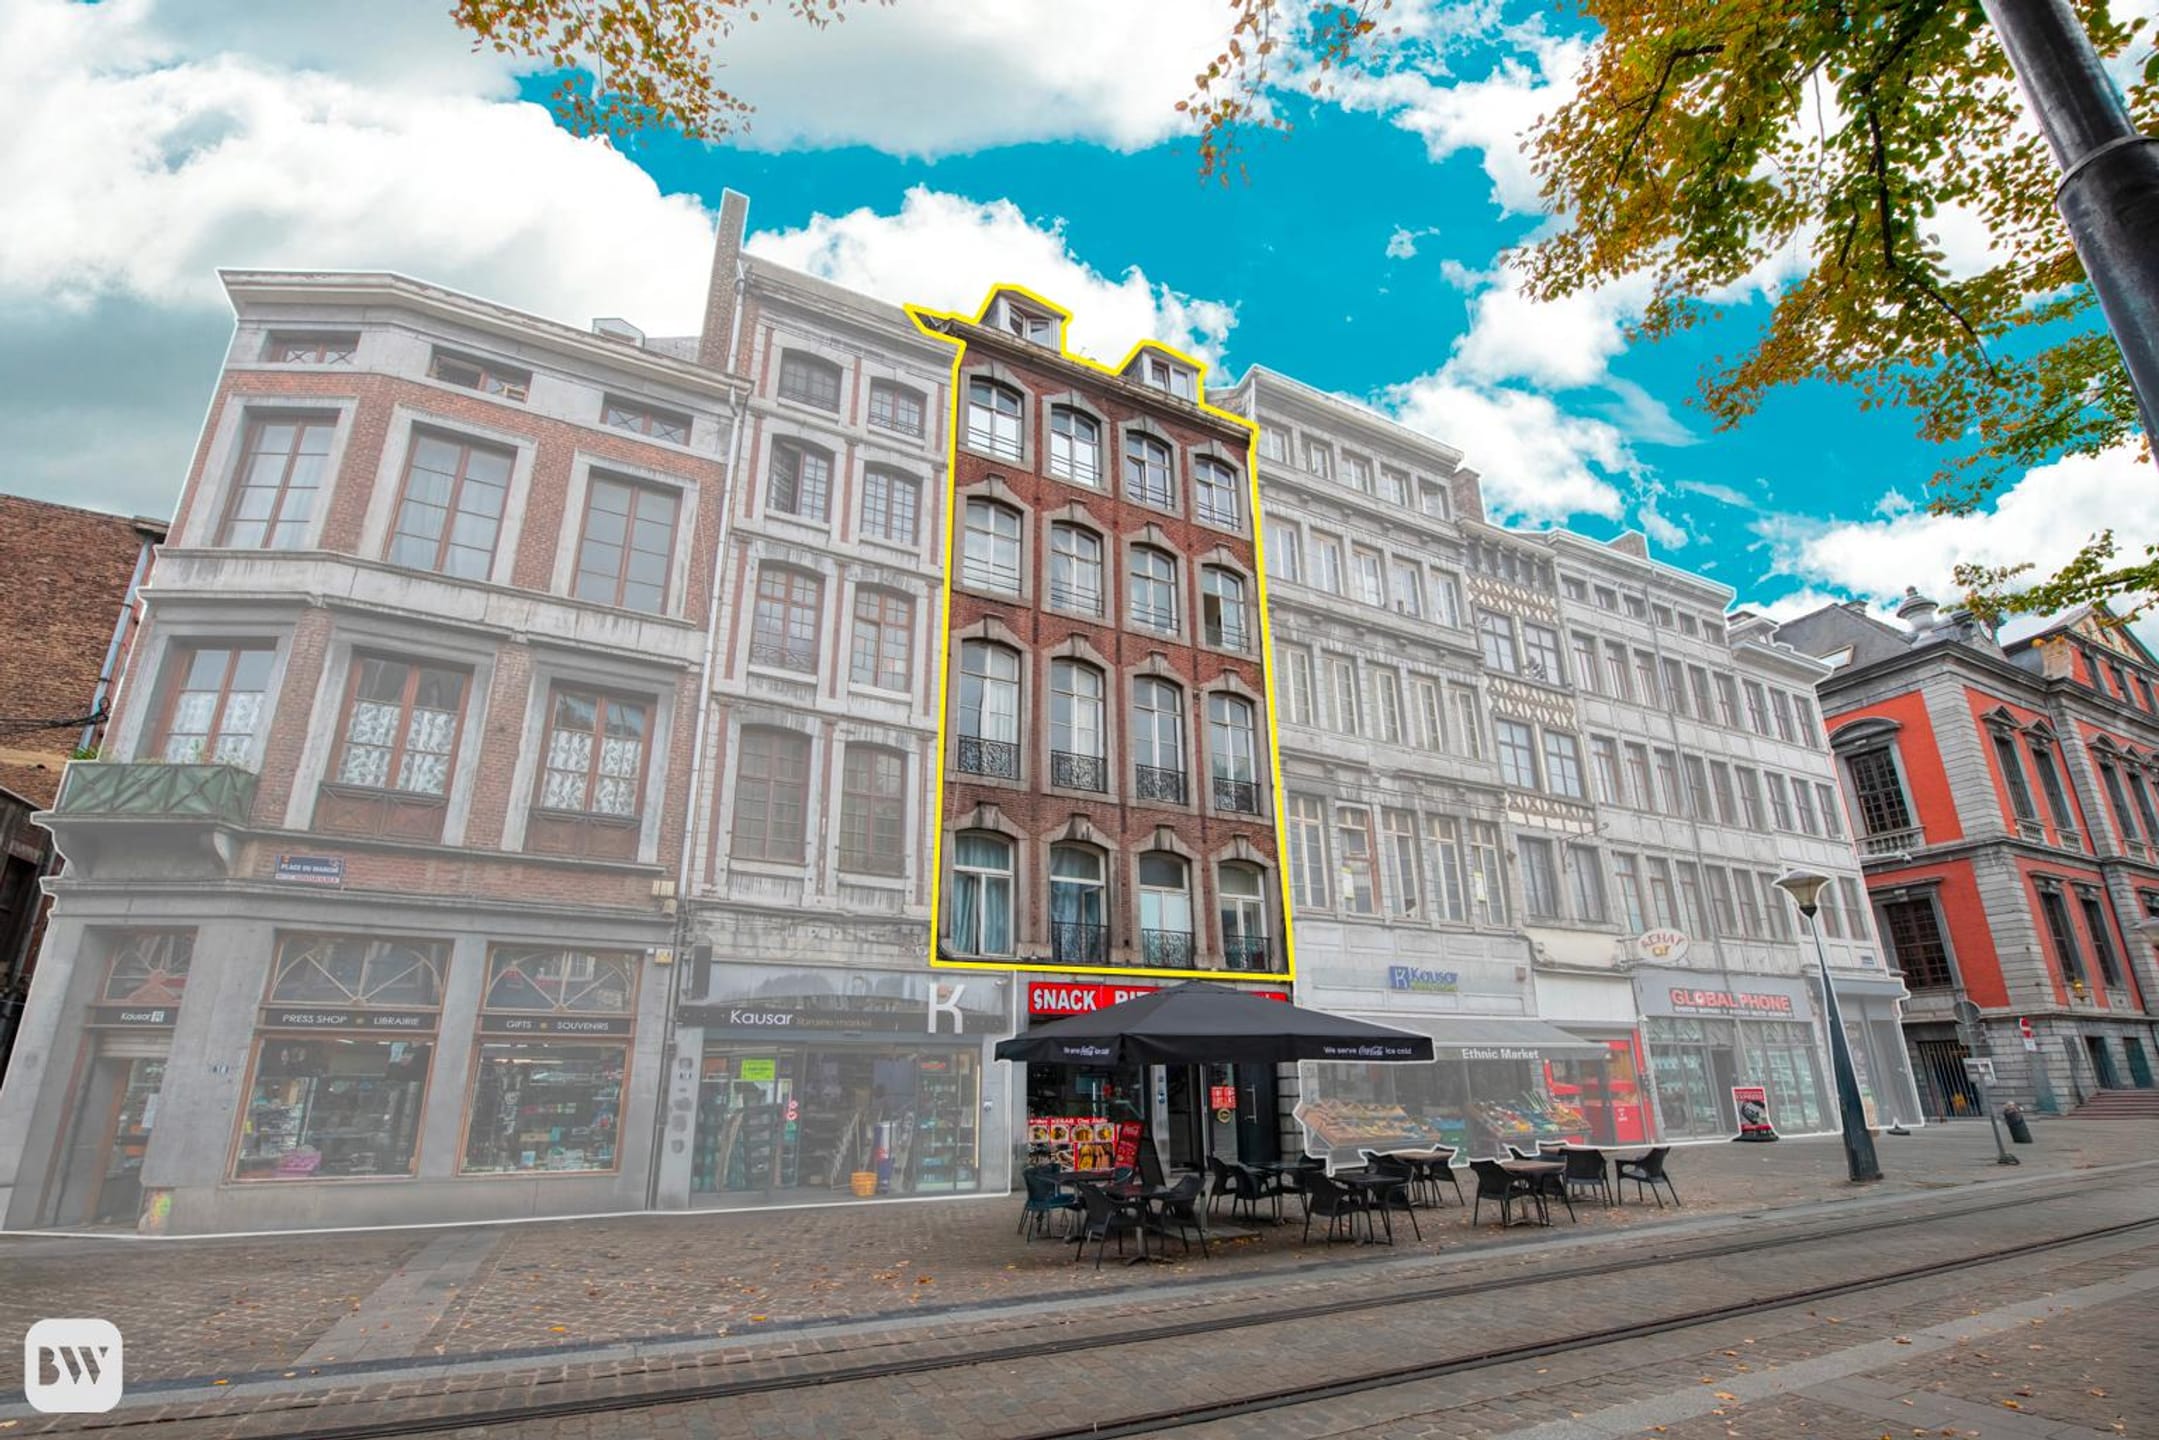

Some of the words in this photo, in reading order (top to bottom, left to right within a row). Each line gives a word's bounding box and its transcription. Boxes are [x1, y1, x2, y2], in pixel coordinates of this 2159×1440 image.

[1034, 988, 1097, 1011] SNACK
[1671, 989, 1739, 1008] GLOBAL
[1739, 993, 1791, 1012] PHONE
[927, 983, 966, 1034] K
[282, 1014, 314, 1023] PRESS
[316, 1014, 348, 1024] SHOP
[373, 1016, 420, 1025] LIBRAIRIE
[730, 1009, 793, 1025] Kausar
[506, 1020, 532, 1029] GIFTS
[557, 1021, 608, 1031] SOUVENIRS
[1462, 1047, 1498, 1059] Ethnic
[1500, 1048, 1539, 1059] Market
